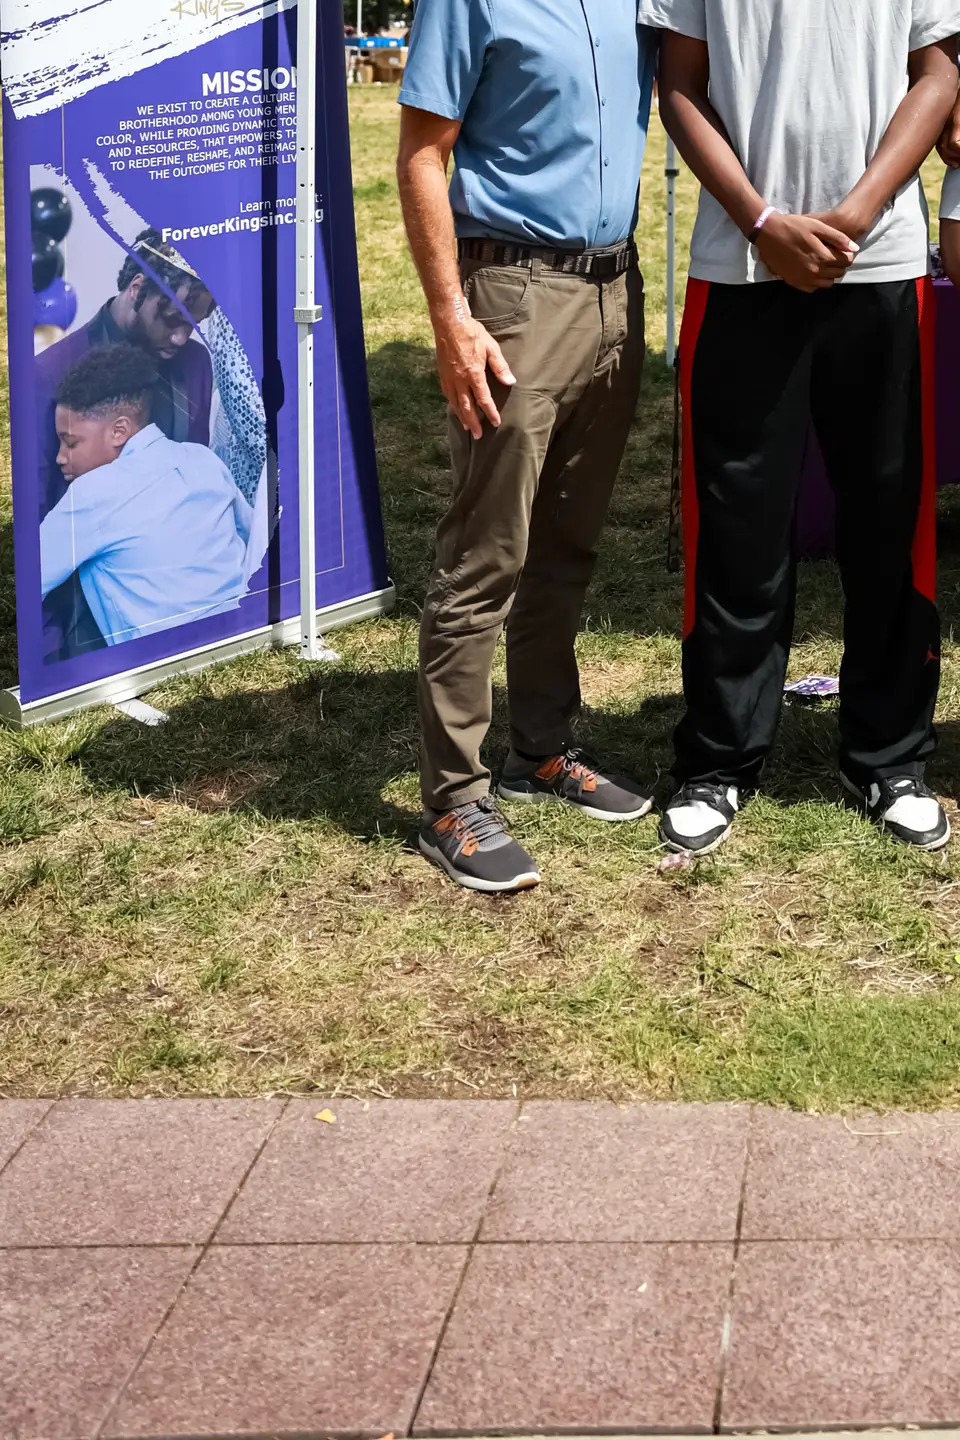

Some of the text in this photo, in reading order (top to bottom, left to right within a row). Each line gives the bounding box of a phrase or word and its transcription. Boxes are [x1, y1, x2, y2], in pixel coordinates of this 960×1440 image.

[120, 104, 296, 131] BROTHERHOOD AMONG YOUNG MEN
[137, 92, 296, 116] WE EXIST TO CREATE A CULTURE
[96, 133, 136, 146] COLOR,
[140, 129, 174, 142] WHILE
[177, 123, 230, 138] PROVIDING
[232, 118, 277, 132] DYNAMIC
[108, 147, 131, 158] AND
[135, 140, 200, 156] RESOURCES,
[202, 136, 225, 148] THAT
[228, 130, 283, 145] EMPOWERS
[110, 141, 296, 171] TO REDEFINE, RESHAPE, AND REIMAG
[148, 153, 297, 180] THE OUTCOMES FOR THEIR LIV
[240, 200, 271, 213] Learn
[275, 197, 297, 208] mor
[161, 209, 324, 242] ForeverKingsinc.g
